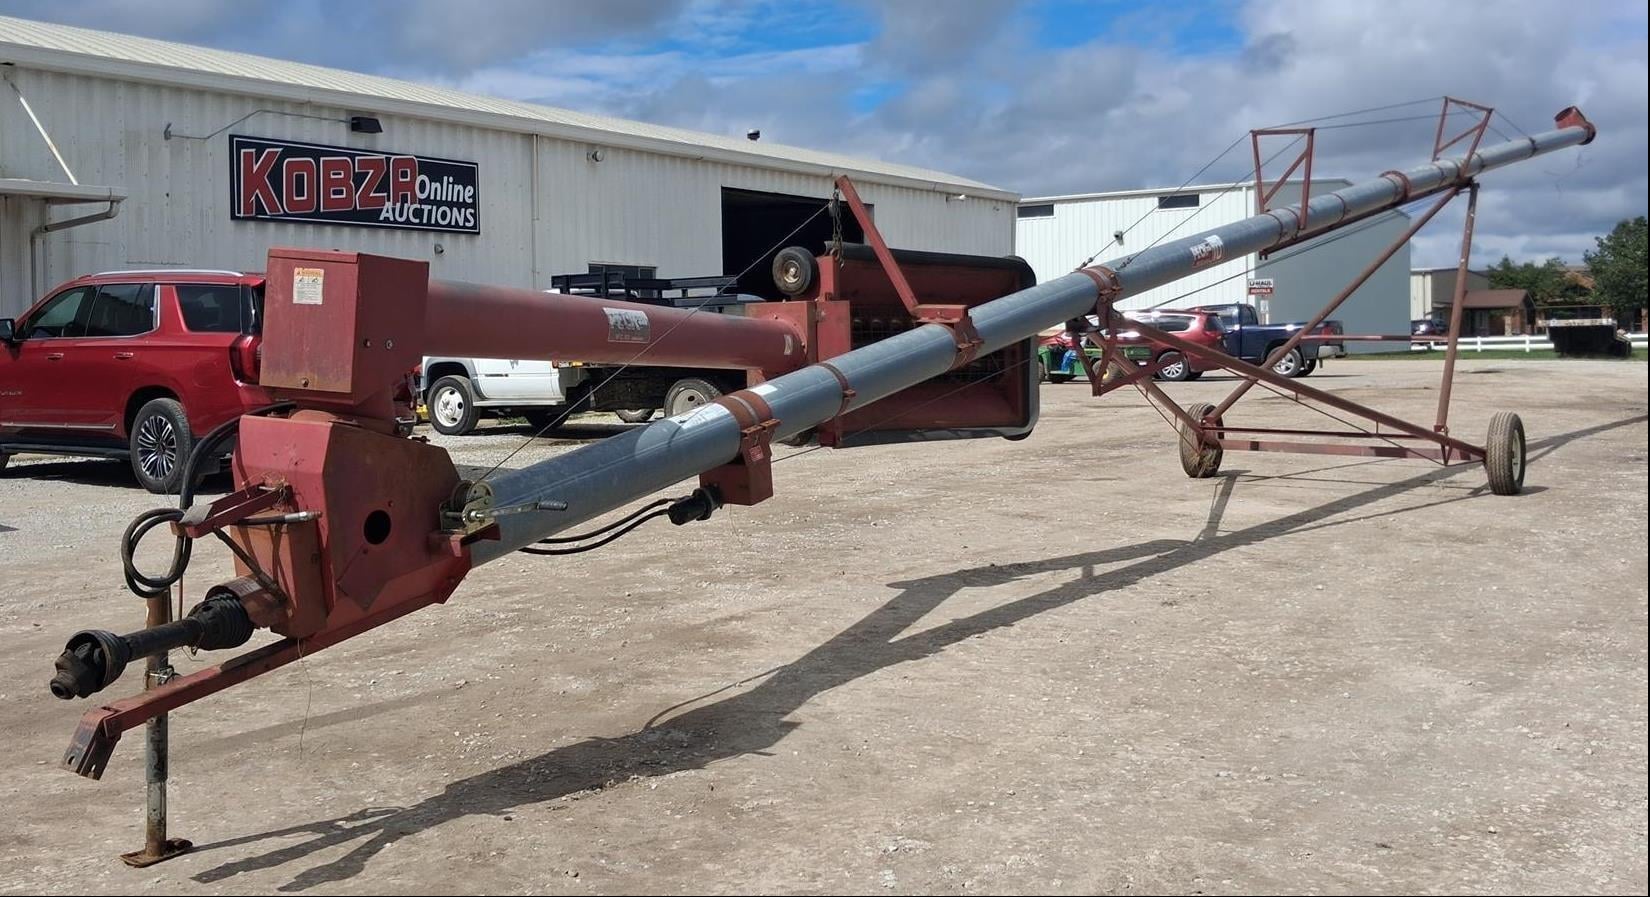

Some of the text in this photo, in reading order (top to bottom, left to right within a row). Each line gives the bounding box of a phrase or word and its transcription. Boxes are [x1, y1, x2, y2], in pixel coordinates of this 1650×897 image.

[240, 148, 419, 217] KOBZA
[415, 175, 473, 203] Online
[379, 201, 475, 227] AUCTIONS
